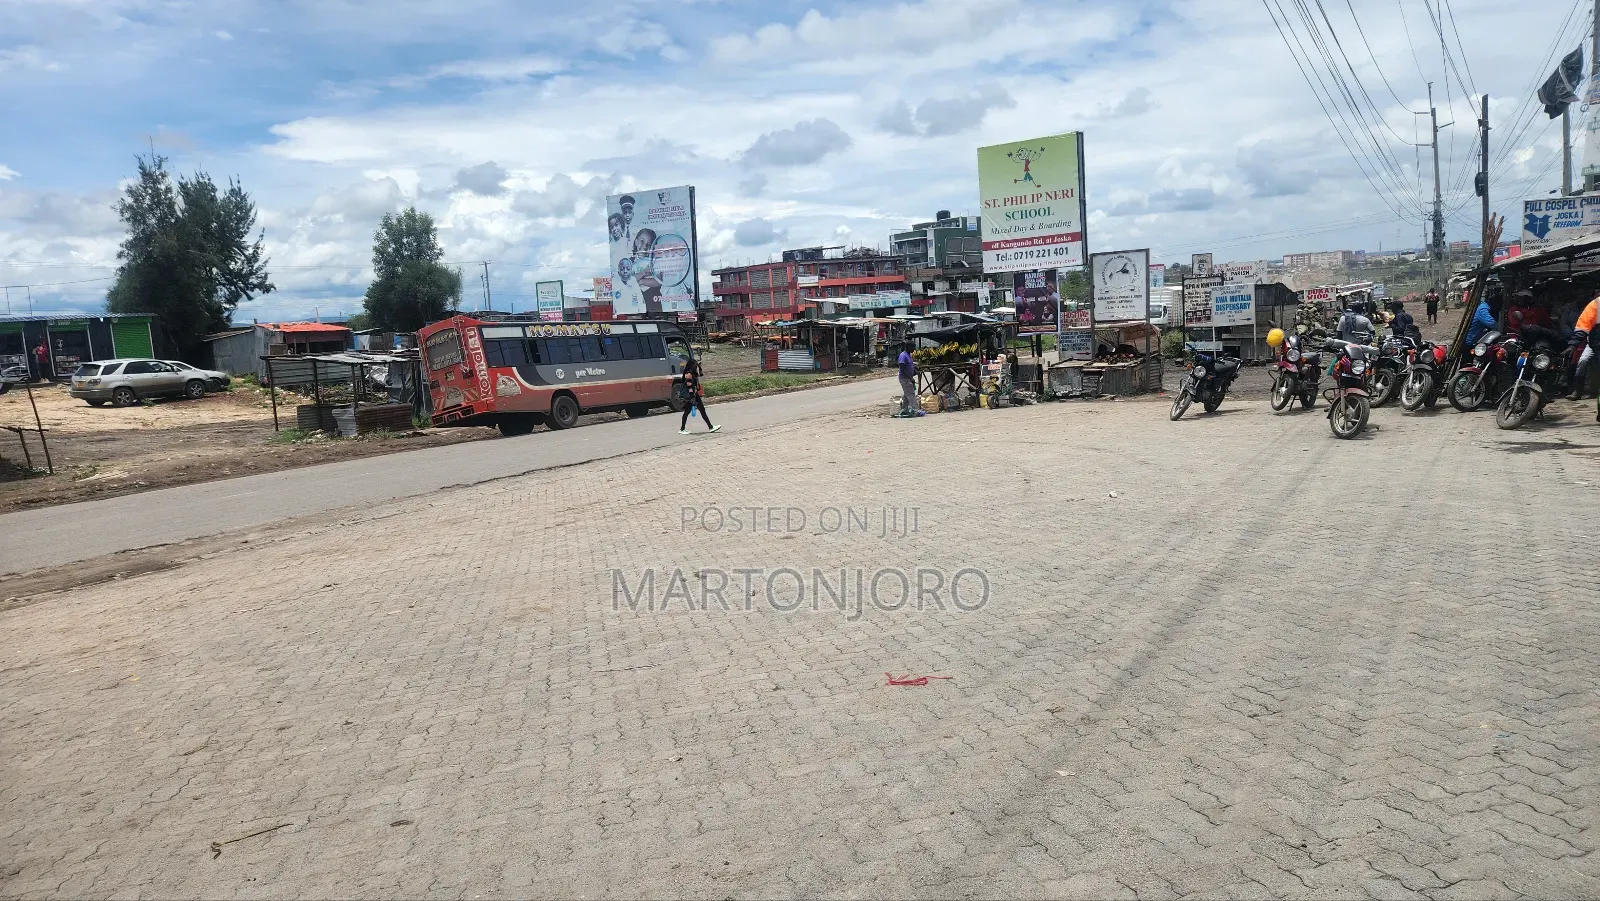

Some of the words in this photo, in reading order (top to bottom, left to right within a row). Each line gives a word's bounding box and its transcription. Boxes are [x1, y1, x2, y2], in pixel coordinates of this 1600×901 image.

[984, 199, 1000, 209] ST.
[1003, 193, 1042, 207] PHILIP
[1045, 188, 1075, 202] NERI
[1524, 201, 1543, 213] FULL
[1545, 200, 1577, 211] GOSPEL
[1005, 206, 1055, 221] SCHOOL
[1555, 211, 1579, 220] JOSKA
[990, 226, 1013, 235] Mixed
[1013, 225, 1028, 234] Day
[1029, 223, 1036, 231] &
[1038, 219, 1072, 230] Boarding
[1552, 219, 1581, 229] FREEDOM
[1000, 239, 1032, 249] Kangundo
[1053, 235, 1072, 243] Joska
[1013, 250, 1034, 261] 0719
[1035, 248, 1051, 259] 221
[1053, 246, 1068, 256] 401
[1307, 288, 1330, 296] DUKA
[1215, 296, 1228, 304] KWA
[1229, 294, 1252, 303] MUTALIA
[1215, 302, 1251, 312] DISPENSARY
[528, 323, 612, 338] KOMATSU
